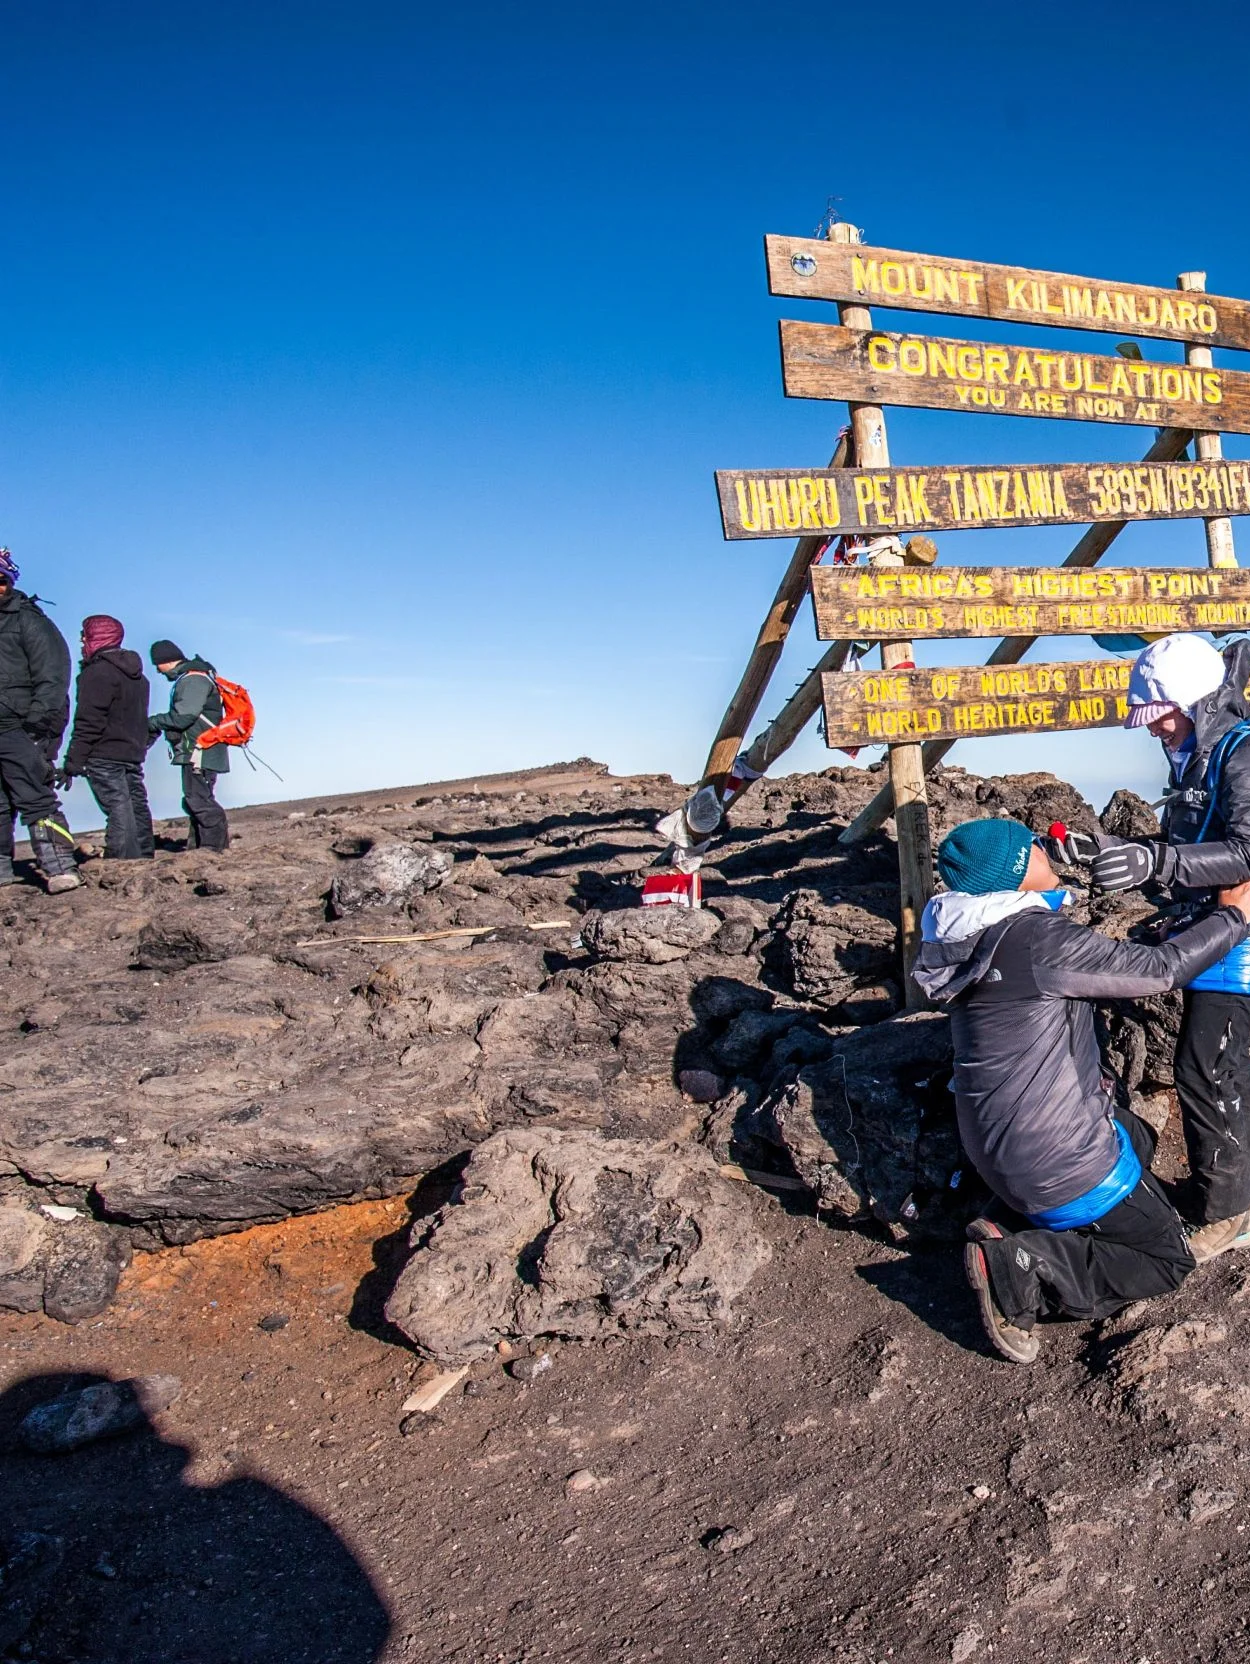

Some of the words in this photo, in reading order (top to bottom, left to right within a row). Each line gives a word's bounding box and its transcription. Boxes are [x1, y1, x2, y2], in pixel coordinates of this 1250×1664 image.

[852, 256, 984, 305] MOUNT
[1006, 277, 1218, 334] KILIMANJARO
[868, 336, 1222, 404] CONGRATULATIONS
[954, 385, 1005, 407] YOU
[1021, 391, 1067, 413] ARE
[1076, 396, 1125, 419] NOW
[1135, 402, 1161, 421] AT
[735, 477, 841, 532] UHURU
[854, 474, 932, 526] PEAK
[1013, 573, 1133, 597] HIGHEST
[1150, 573, 1223, 597] POINT
[963, 605, 1040, 628] HIGHEST
[864, 676, 911, 704] ONE
[931, 674, 961, 700] OF
[1079, 665, 1131, 692] LARG
[867, 708, 942, 737] WORLD
[953, 701, 1056, 731] HERITAGE
[1068, 698, 1105, 722] AND
